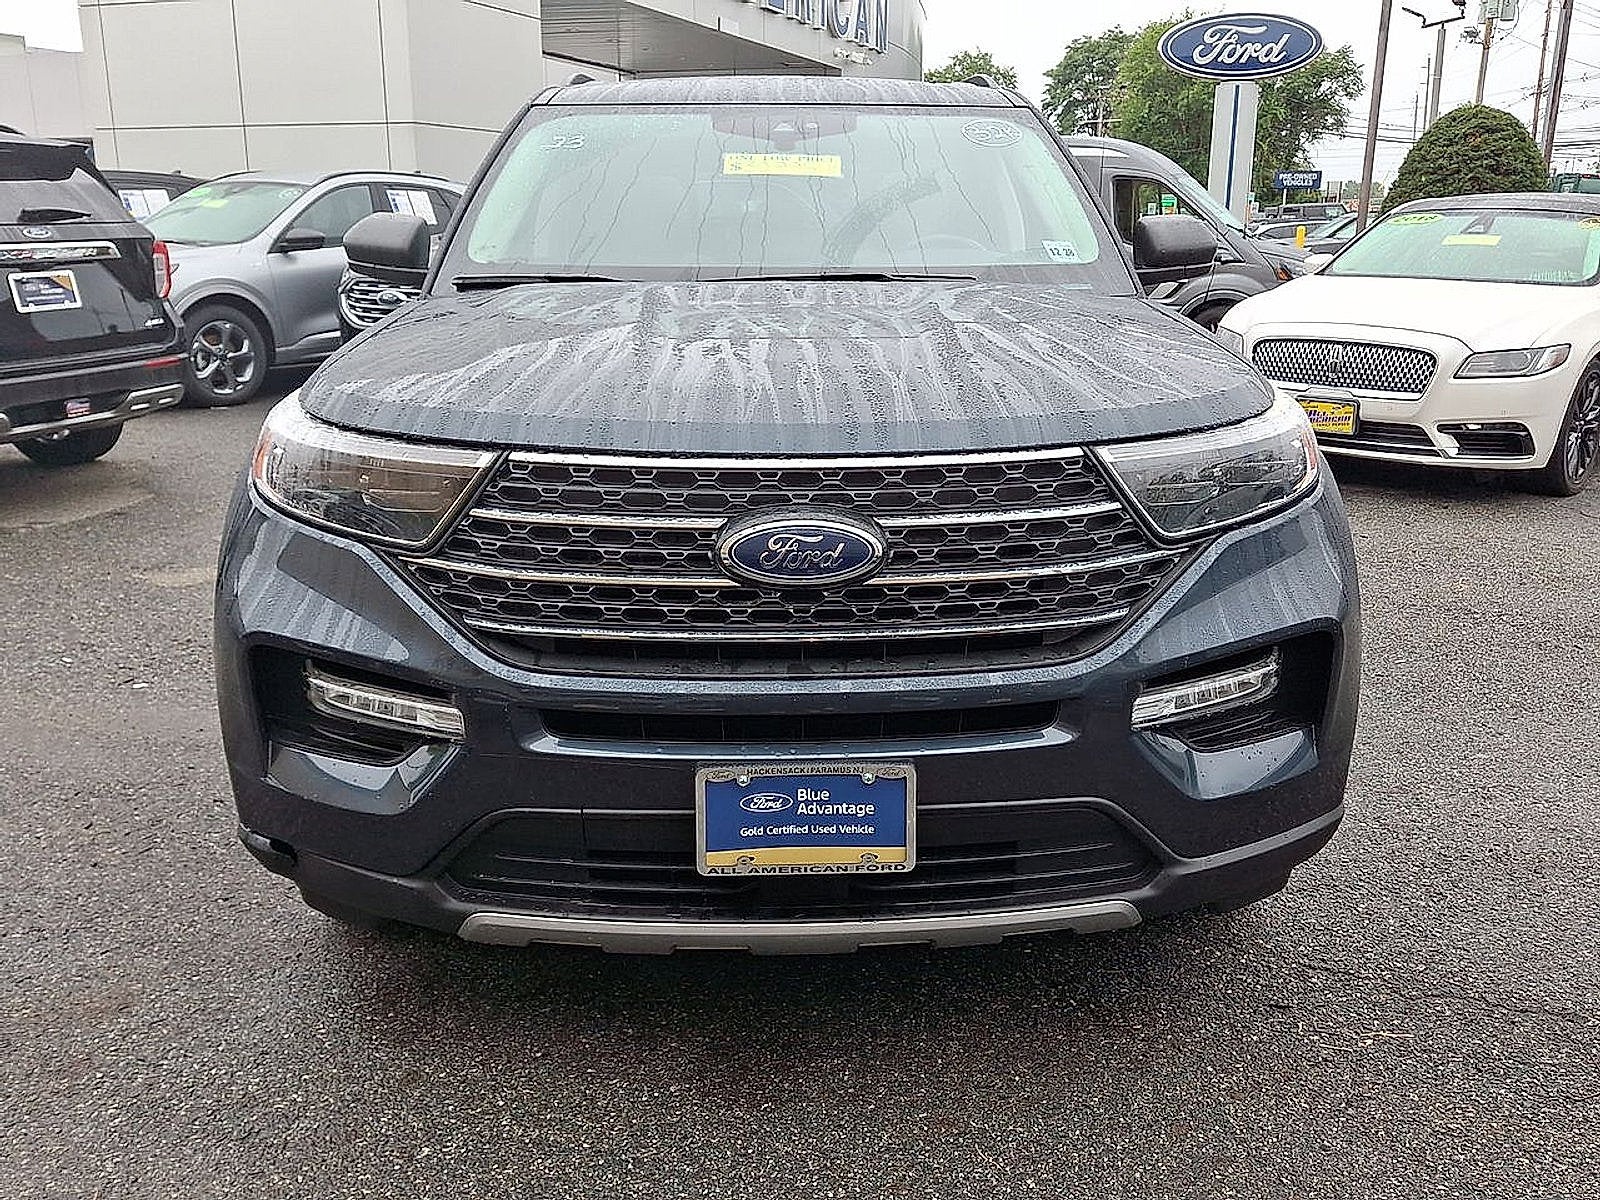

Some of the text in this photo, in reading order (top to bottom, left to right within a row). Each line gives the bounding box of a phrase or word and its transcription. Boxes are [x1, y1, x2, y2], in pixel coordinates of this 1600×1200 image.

[1192, 24, 1292, 65] Ford
[760, 533, 845, 569] Ford
[797, 788, 830, 801] Blue
[750, 795, 783, 809] Ford
[797, 802, 875, 818] Advantage
[740, 825, 875, 837] Gold Certified Used Vehicle
[707, 863, 907, 875] ALL AMERICAN FORD
